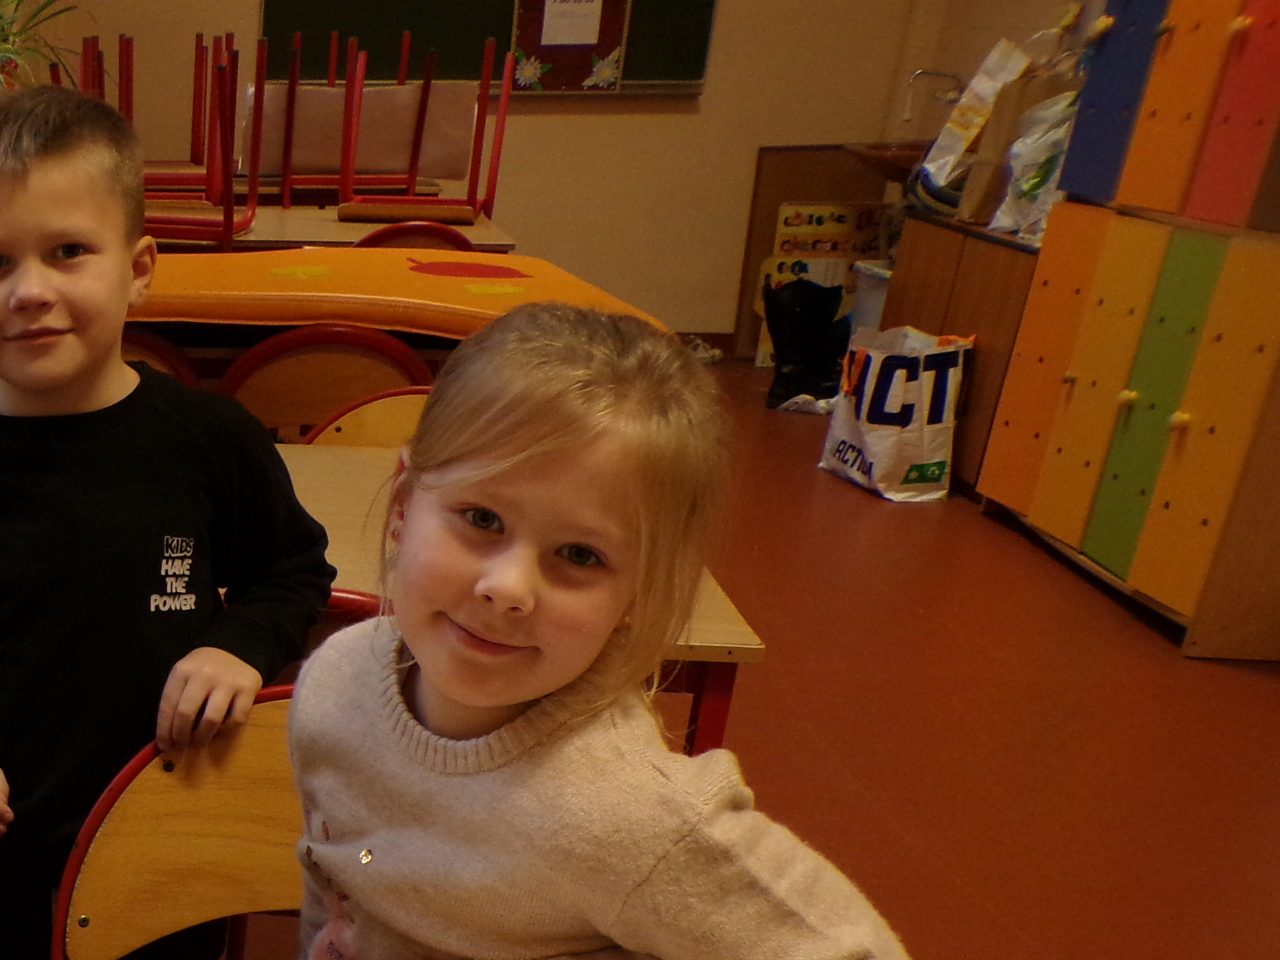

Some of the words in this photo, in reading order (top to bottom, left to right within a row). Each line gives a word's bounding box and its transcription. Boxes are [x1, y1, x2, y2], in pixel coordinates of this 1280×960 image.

[164, 535, 195, 557] KIDS
[161, 558, 192, 575] HAVE
[166, 577, 189, 593] THE
[150, 594, 196, 612] POWER
